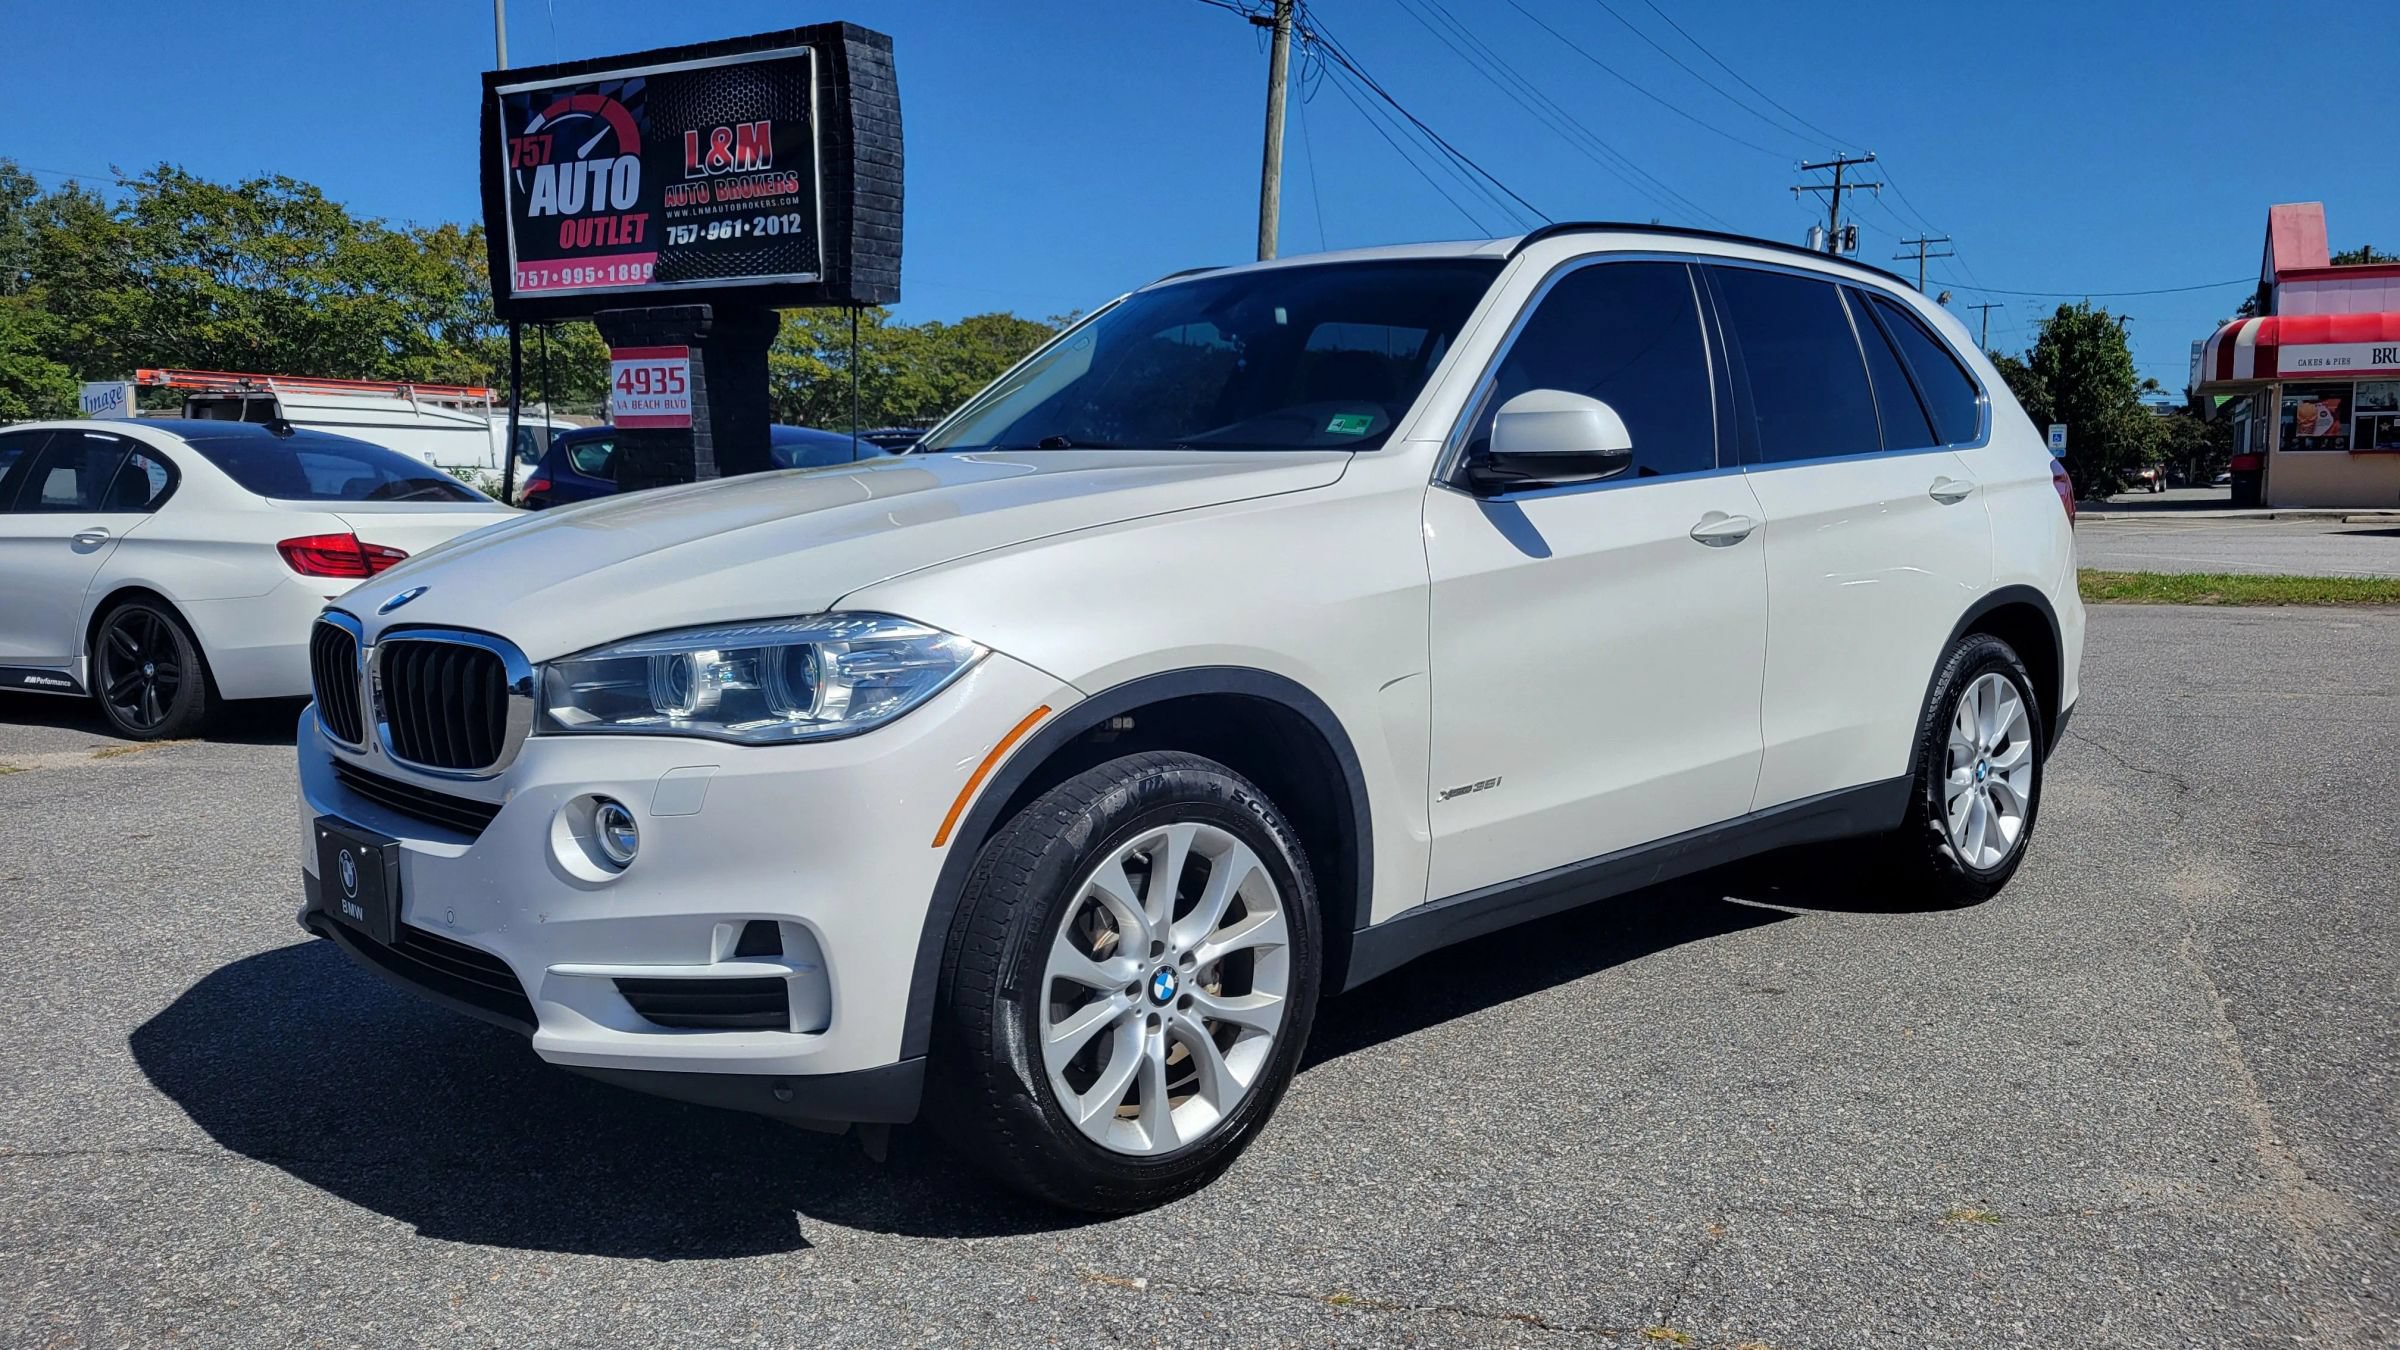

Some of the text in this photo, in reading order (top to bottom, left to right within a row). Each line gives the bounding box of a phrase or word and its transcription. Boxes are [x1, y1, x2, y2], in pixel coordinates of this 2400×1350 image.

[509, 134, 553, 168] 757
[684, 120, 773, 179] L&M
[528, 154, 641, 217] AUTO
[664, 170, 800, 208] AUTO BROKERS
[559, 213, 649, 249] OUTLET
[2297, 358, 2323, 367] CAKES
[2333, 357, 2351, 366] PIES
[616, 366, 685, 396] 4935
[83, 385, 122, 414] Image
[631, 399, 660, 410] BEACH
[664, 399, 687, 409] BLVD
[341, 899, 363, 921] BMW
